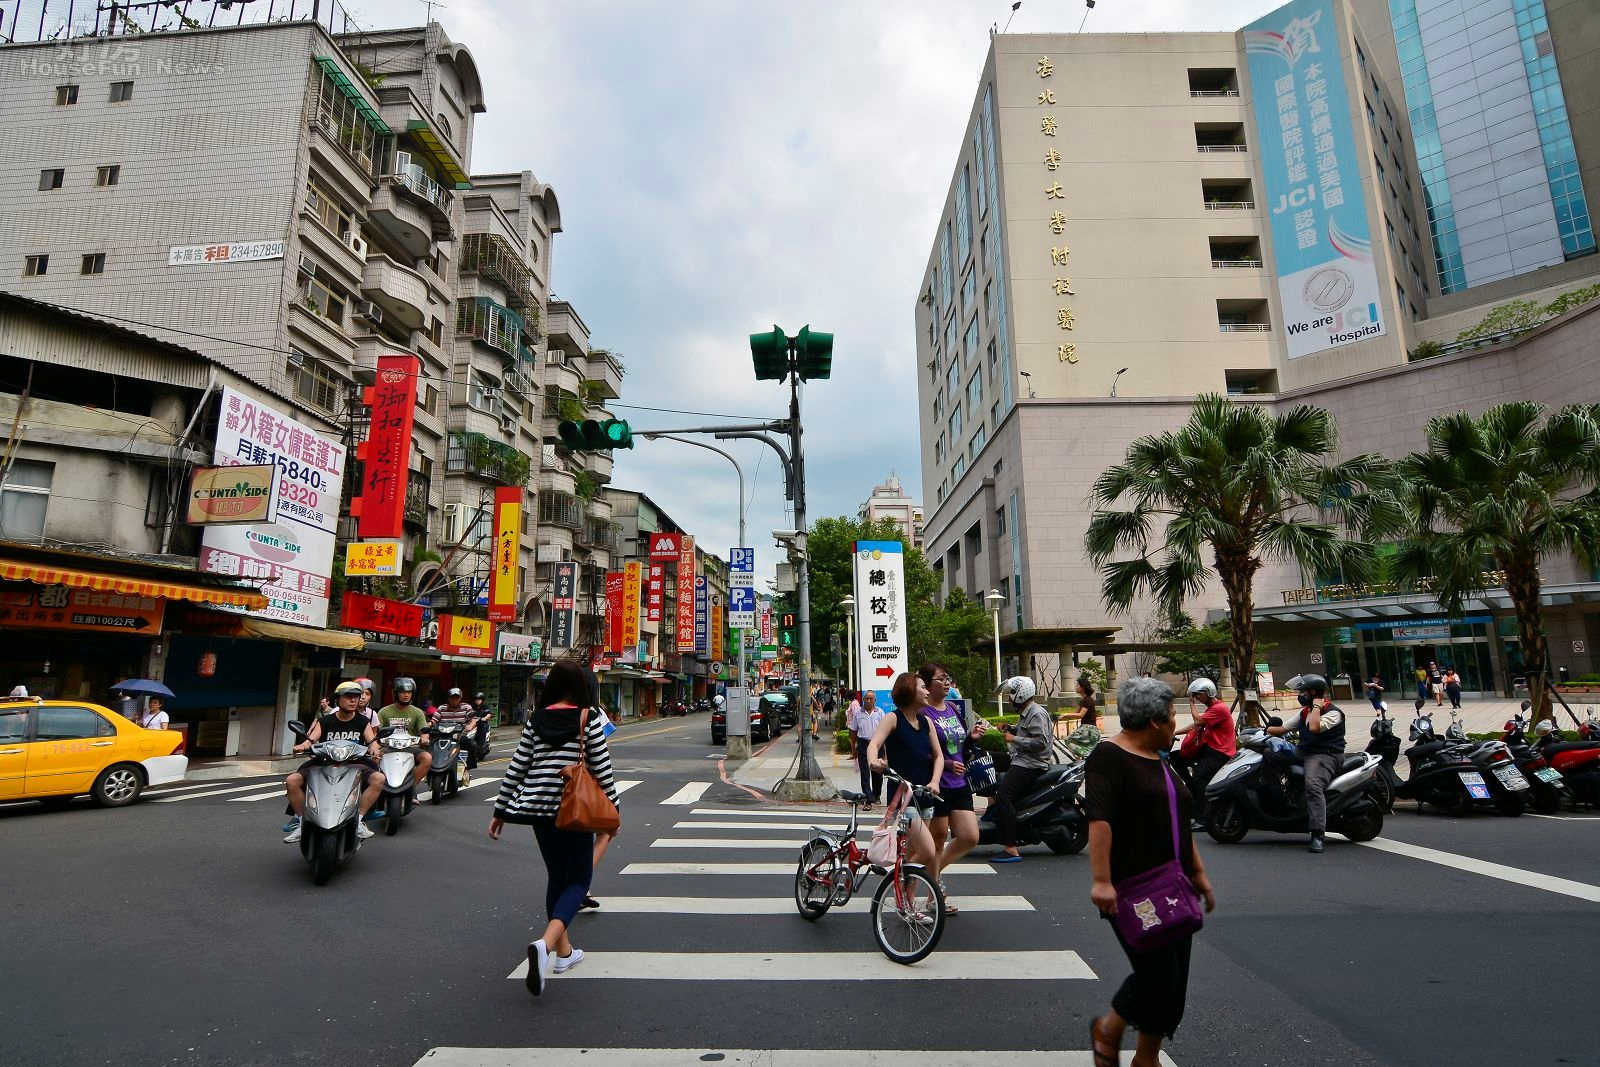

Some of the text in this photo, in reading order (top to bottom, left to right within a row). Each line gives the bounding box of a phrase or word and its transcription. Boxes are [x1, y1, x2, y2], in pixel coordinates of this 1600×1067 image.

[1303, 62, 1344, 210] 本院高標通過美國
[1273, 184, 1317, 214] JCI
[1294, 208, 1318, 250] 認證
[204, 245, 230, 261] 租
[1287, 302, 1379, 336] We are JCI
[1329, 322, 1381, 345] Hospital
[239, 402, 342, 477] 外籍女傭監護工
[731, 548, 745, 565] P
[732, 588, 746, 605] P
[1281, 587, 1318, 605] TAIPEI
[869, 569, 889, 643] 總校區
[74, 614, 135, 627] 往前100公尺
[868, 645, 901, 654] University
[871, 652, 898, 661] Campus
[326, 731, 361, 741] RADAR
